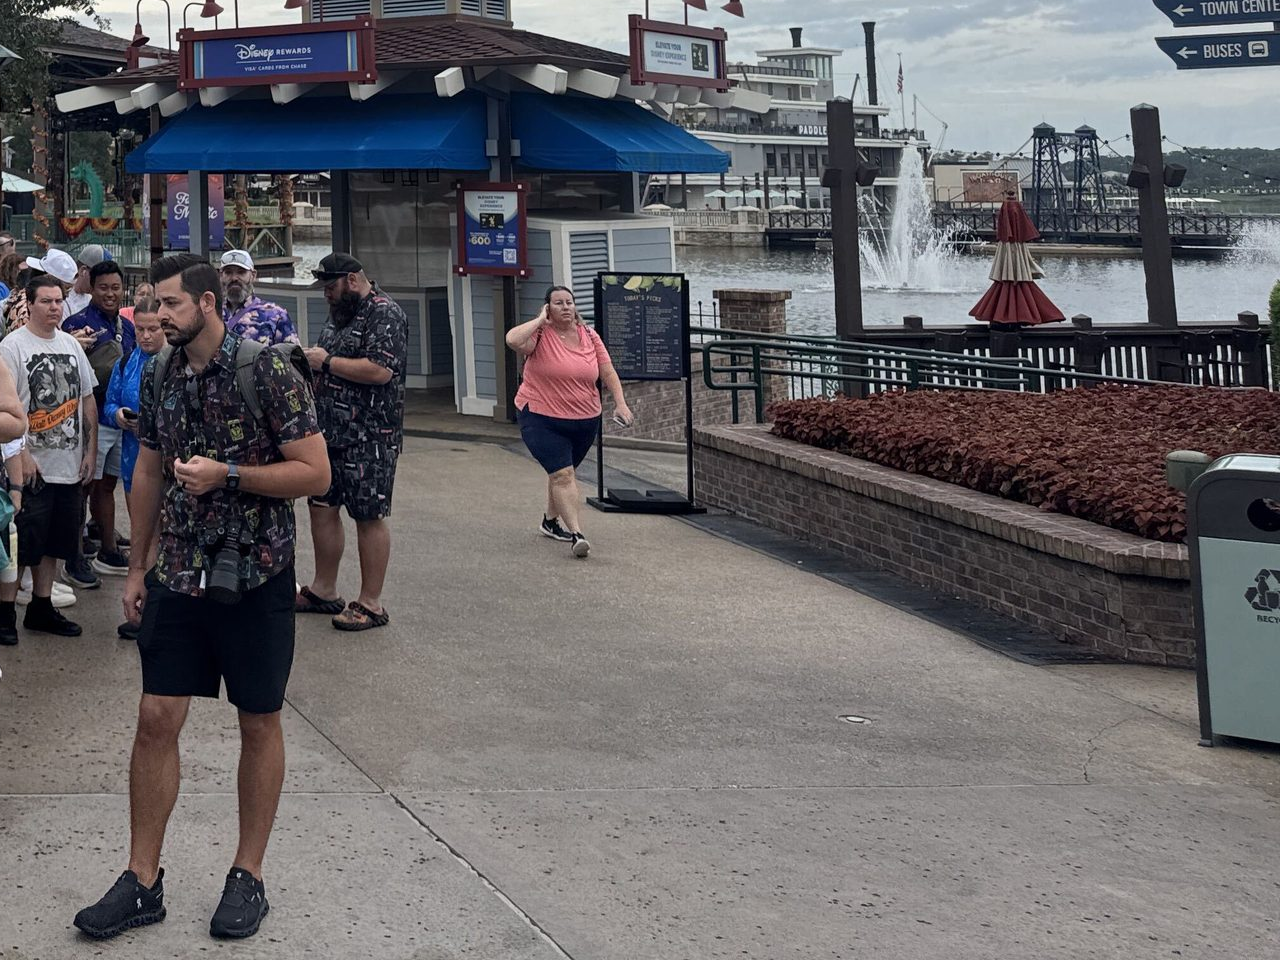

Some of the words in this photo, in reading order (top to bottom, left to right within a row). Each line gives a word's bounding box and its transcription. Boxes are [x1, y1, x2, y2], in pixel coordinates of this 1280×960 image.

[1200, 0, 1238, 16] TOWN
[234, 43, 274, 62] Disney
[275, 47, 312, 56] REWARDS
[1203, 43, 1242, 58] BUSES
